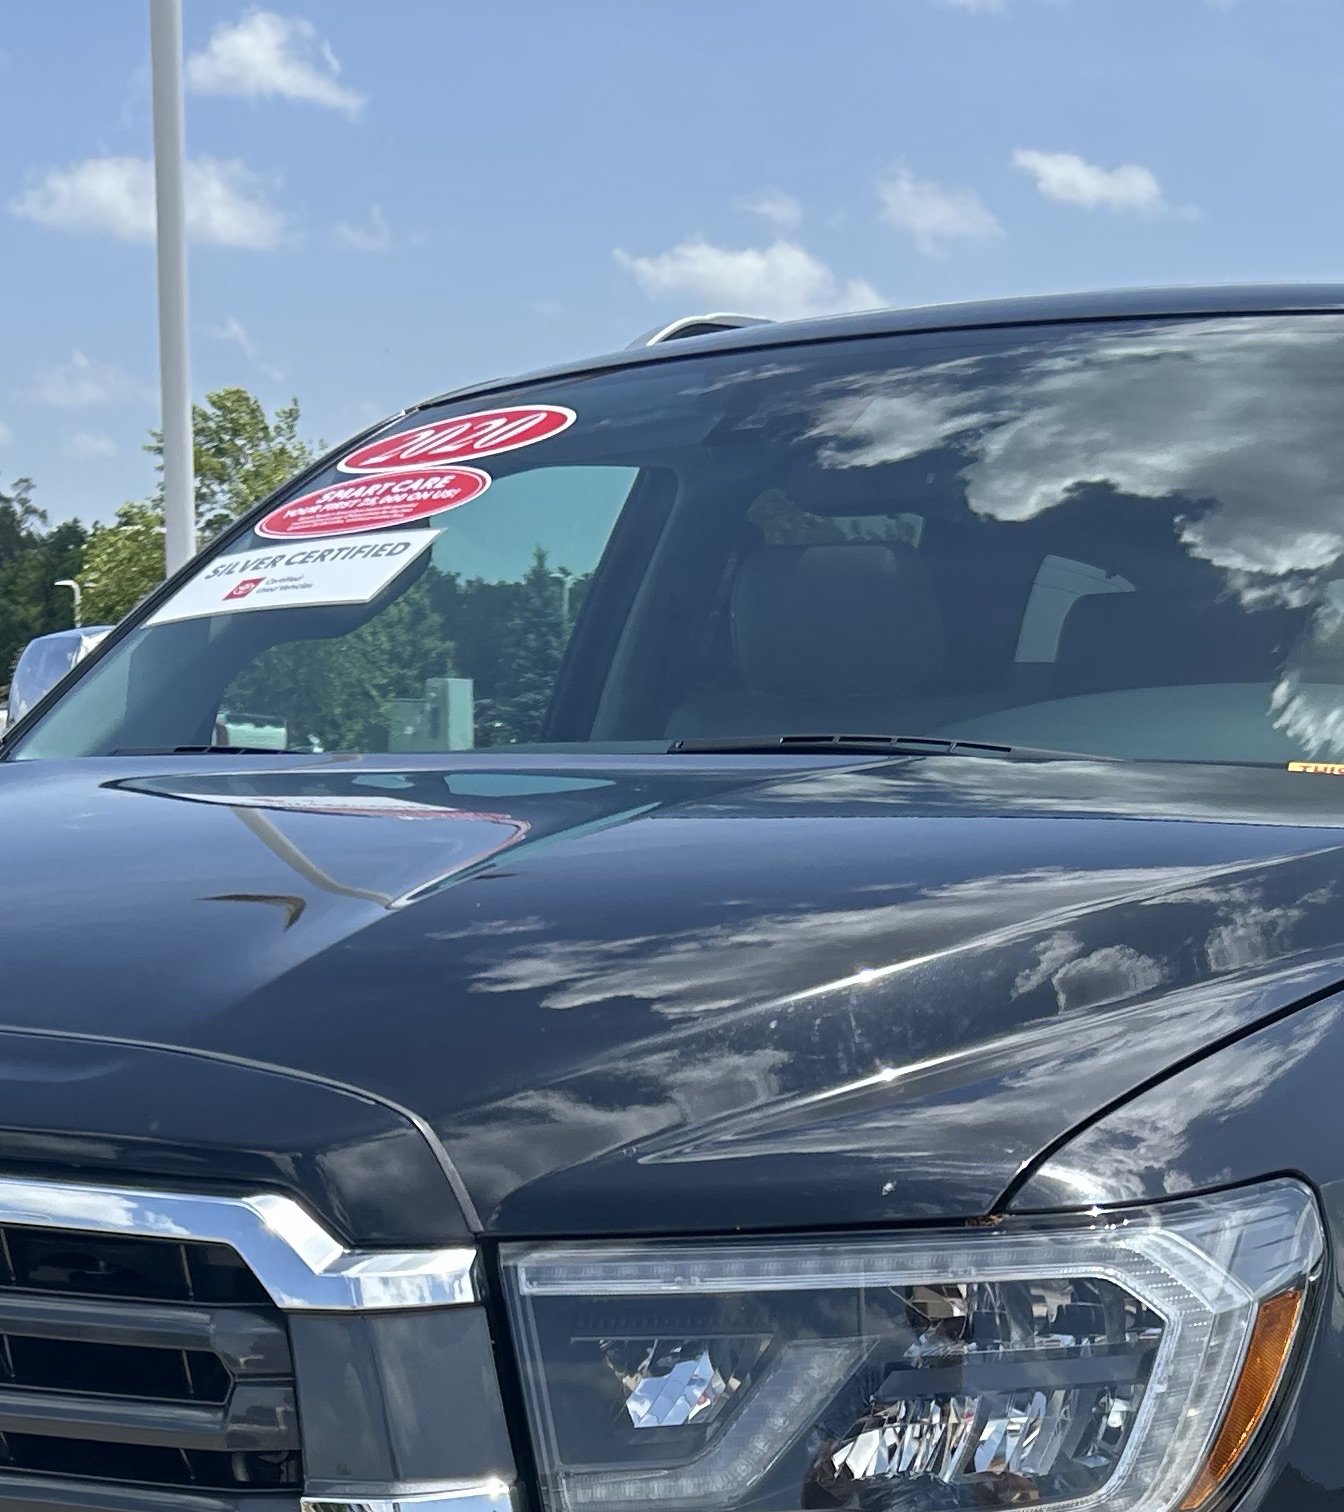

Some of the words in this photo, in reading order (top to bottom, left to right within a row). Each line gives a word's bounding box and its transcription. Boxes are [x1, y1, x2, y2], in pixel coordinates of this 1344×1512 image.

[358, 412, 548, 466] 2020
[316, 482, 397, 505] SMART
[391, 475, 457, 493] CARE
[204, 556, 284, 579] SILVER
[283, 541, 412, 567] CERTIFIED
